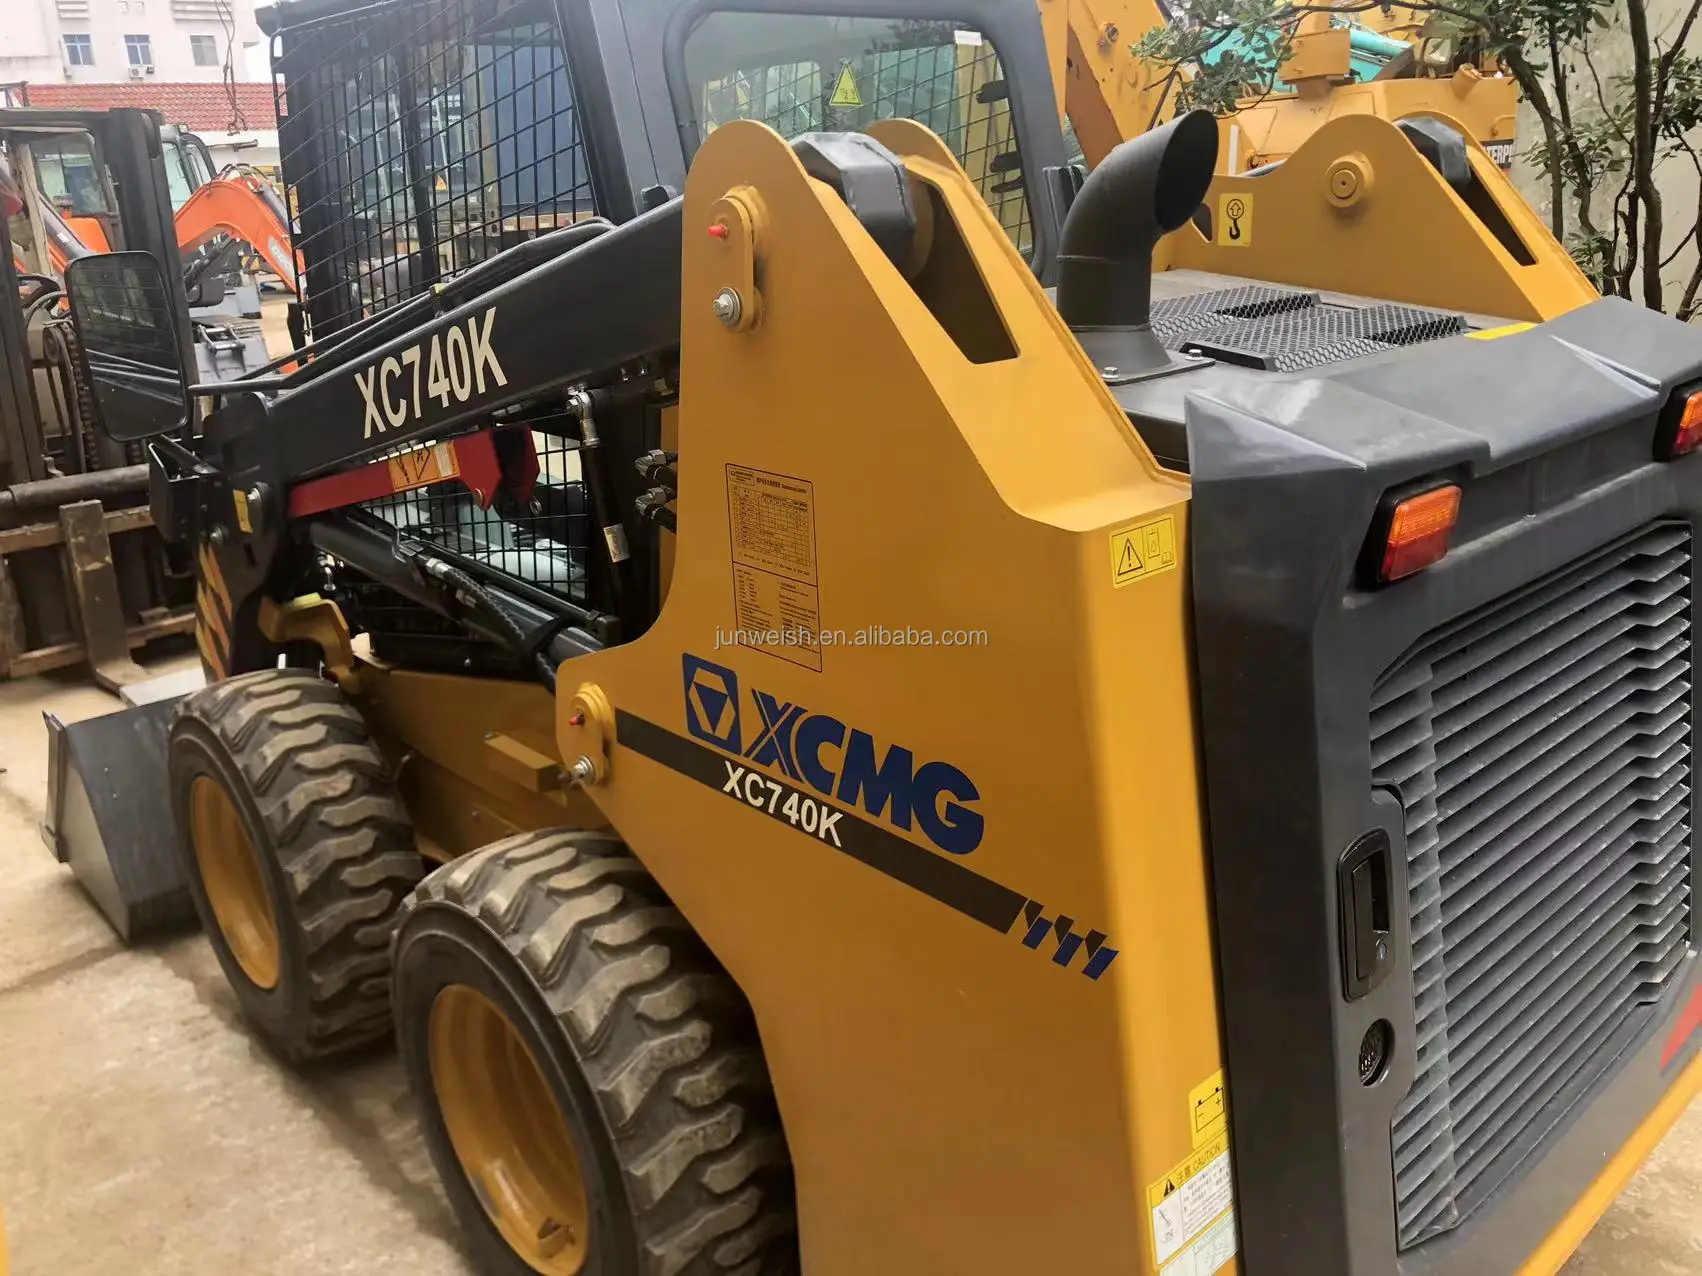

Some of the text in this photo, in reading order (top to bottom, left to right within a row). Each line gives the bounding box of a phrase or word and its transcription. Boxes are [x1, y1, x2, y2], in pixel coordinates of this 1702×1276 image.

[1483, 144, 1513, 164] TERPI
[354, 306, 508, 439] XC740K
[722, 760, 844, 848] XC740K
[744, 688, 985, 855] XCMG
[1193, 1143, 1220, 1170] CAUTION
